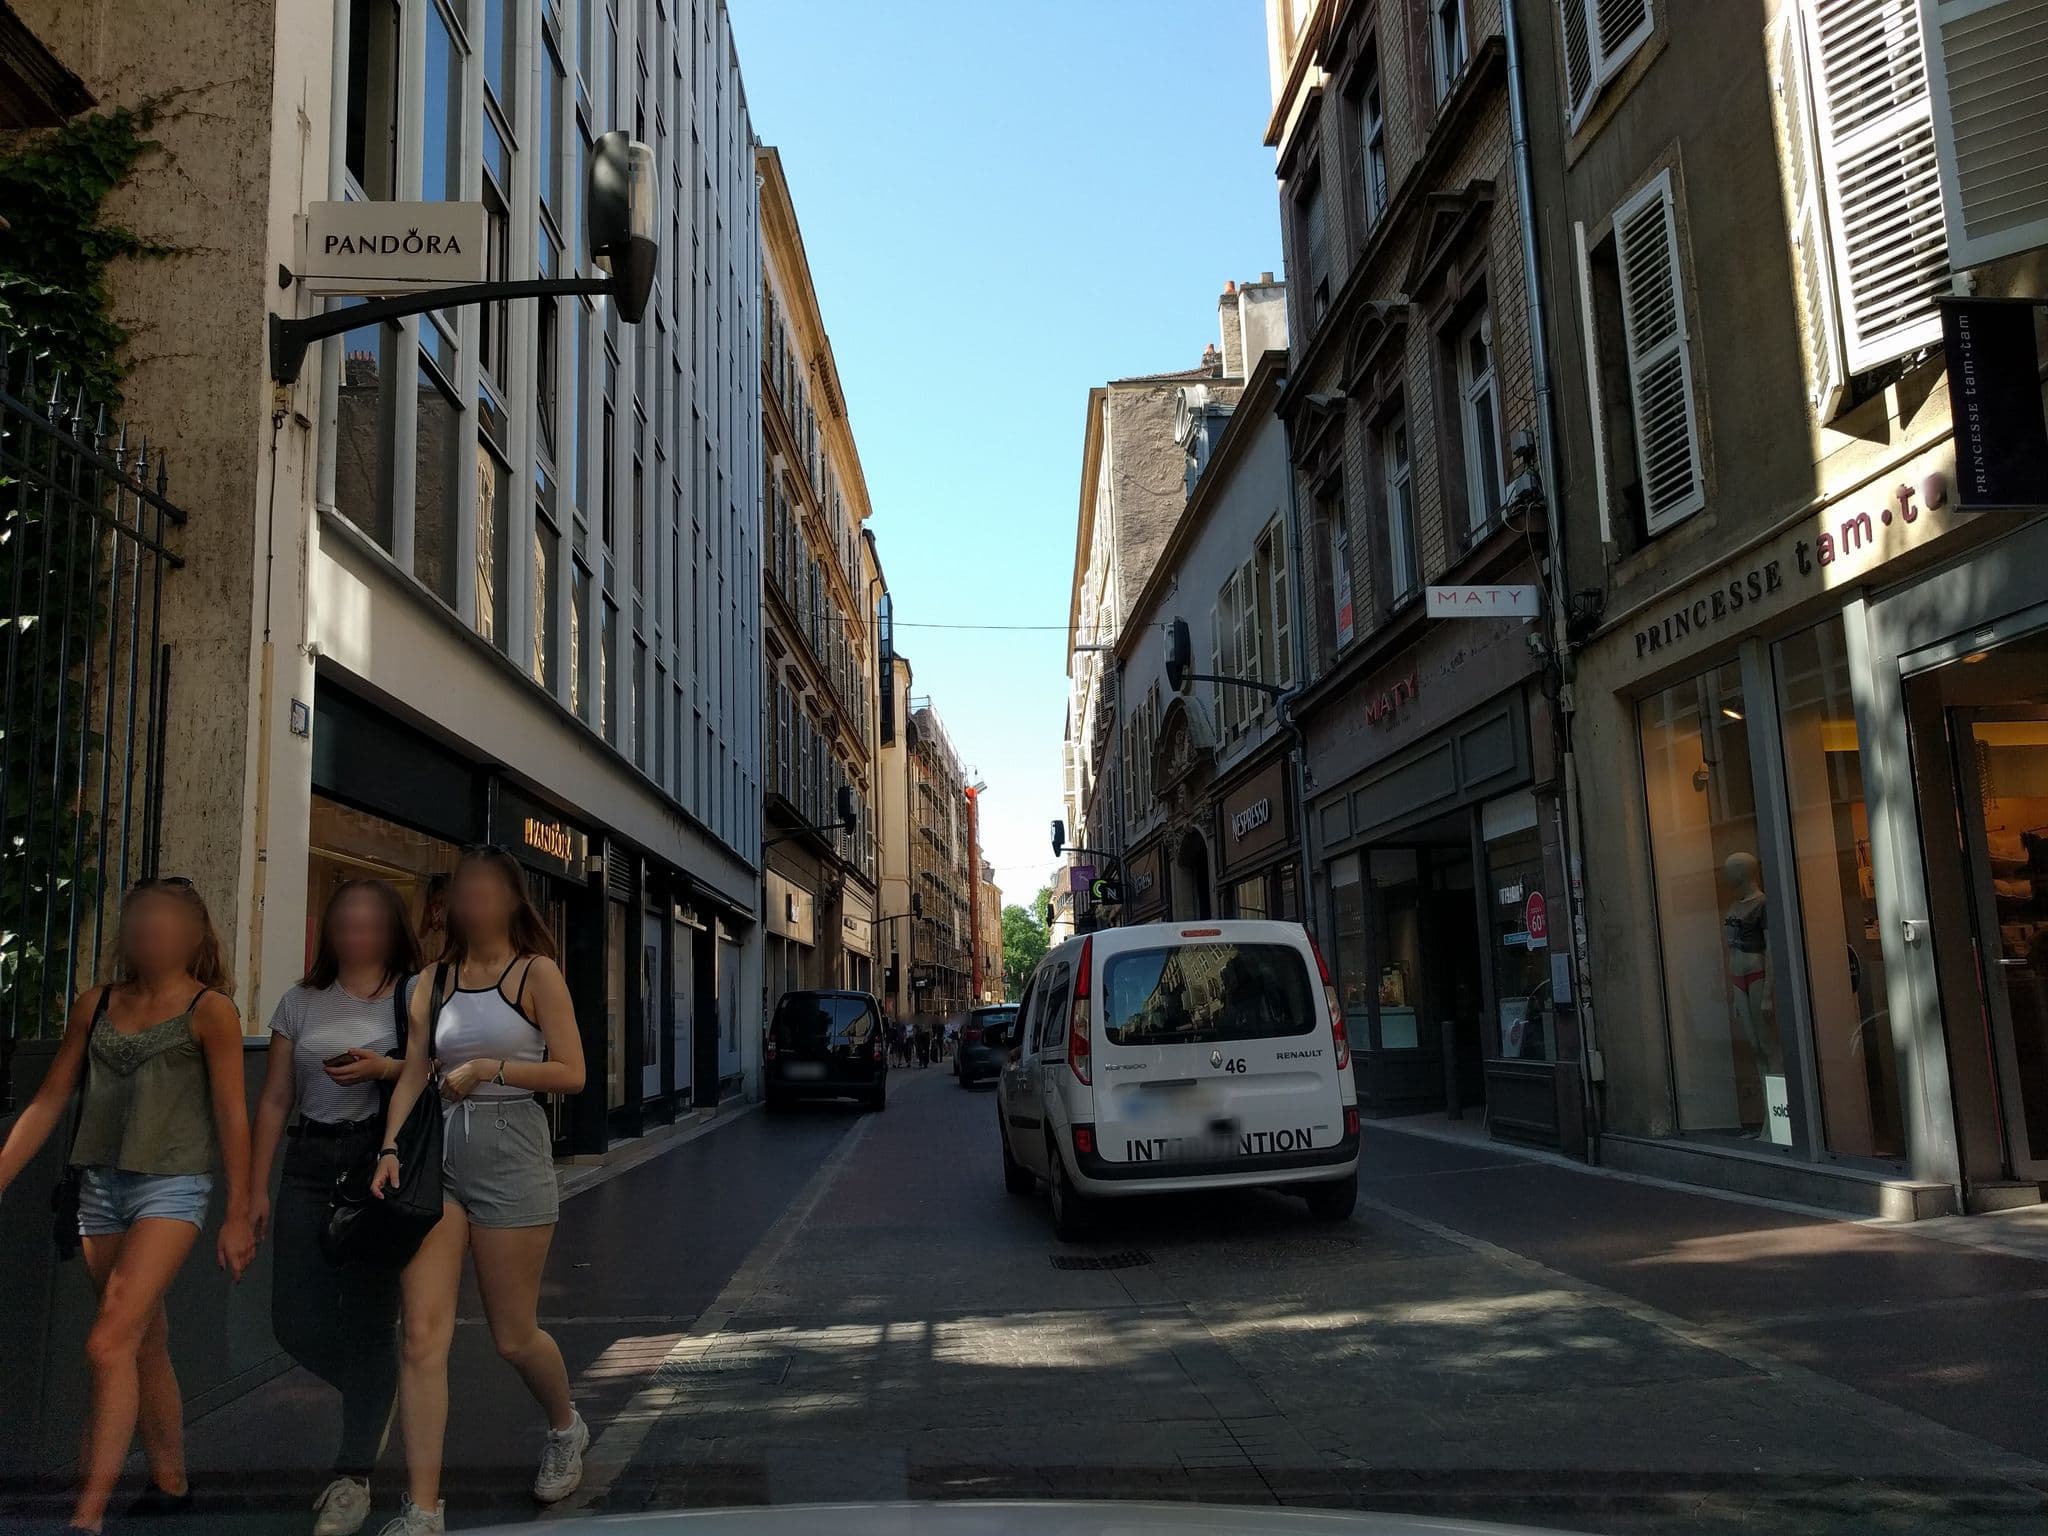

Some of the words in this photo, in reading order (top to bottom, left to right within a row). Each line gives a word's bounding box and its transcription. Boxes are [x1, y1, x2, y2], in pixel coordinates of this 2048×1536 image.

[325, 230, 462, 255] PANDORA
[1968, 403, 1988, 493] PRINCESSE
[1437, 590, 1522, 605] MATY
[1633, 559, 1784, 658] PRINCESSE
[1364, 671, 1418, 727] MATY
[1231, 798, 1270, 843] NESPRESSO
[1225, 1058, 1247, 1074] 46
[1276, 1049, 1324, 1060] RENAULT
